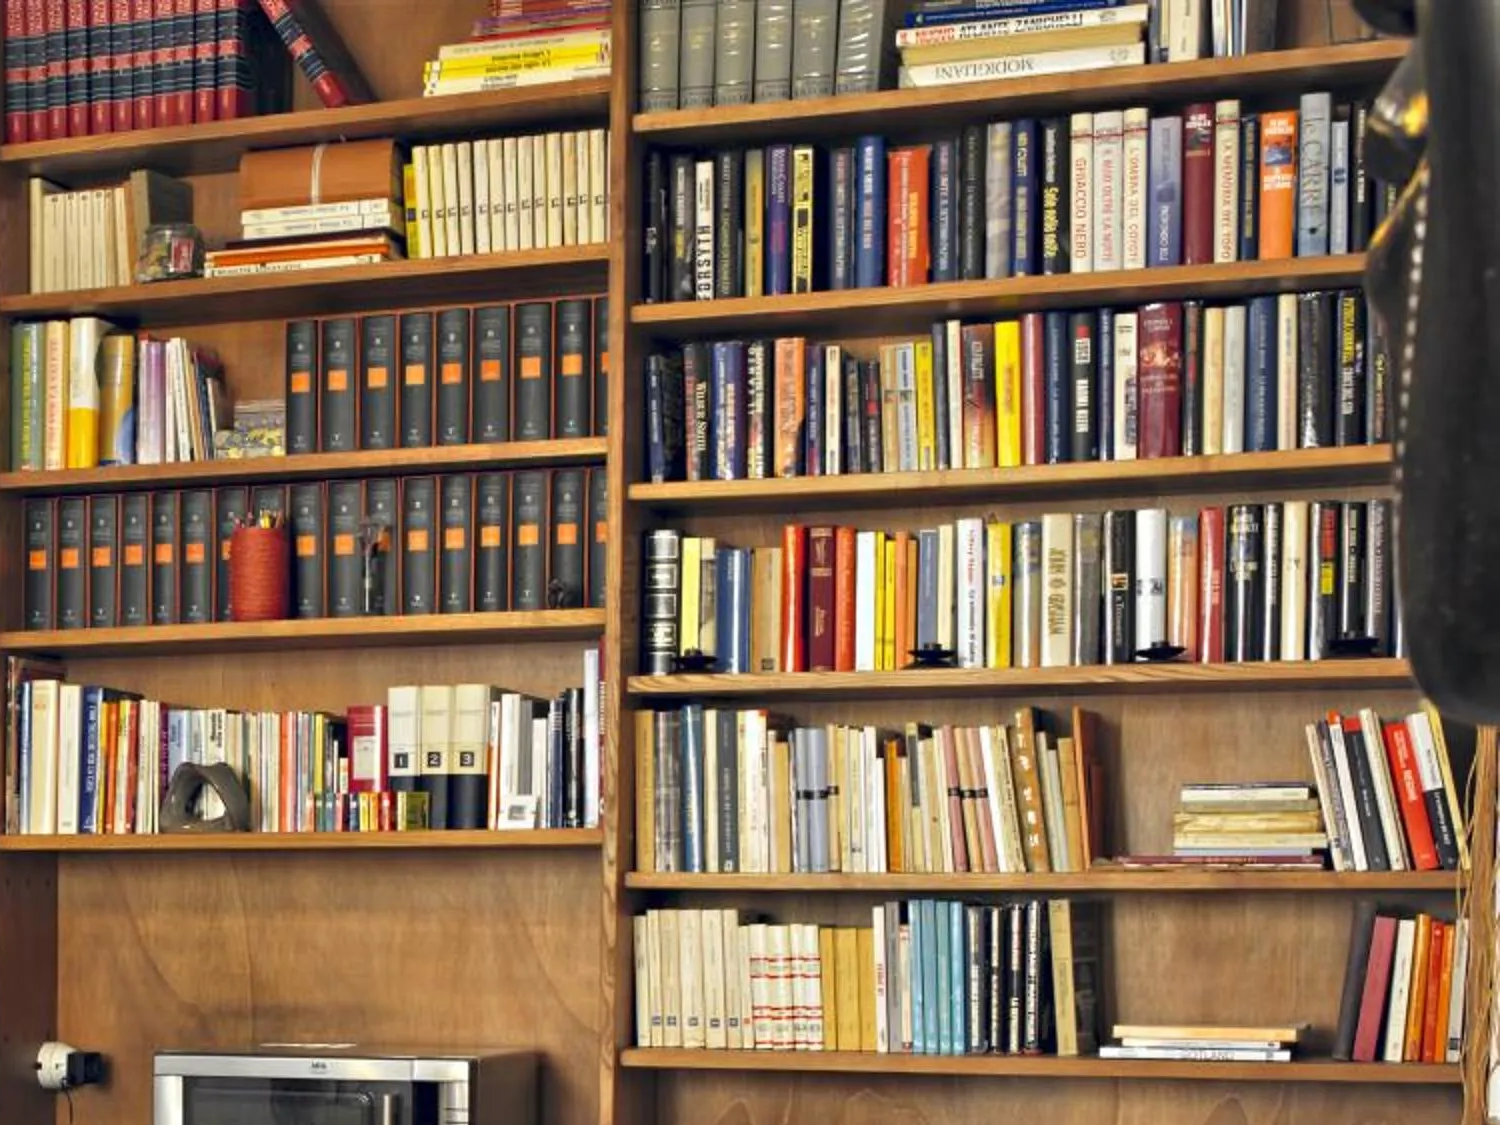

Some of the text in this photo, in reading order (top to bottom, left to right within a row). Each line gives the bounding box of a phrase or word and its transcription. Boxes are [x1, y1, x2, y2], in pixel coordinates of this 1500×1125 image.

[935, 58, 1035, 80] MODIGLIANI
[1075, 157, 1088, 220] GHIACCIO
[1221, 155, 1234, 207] MEMORIA
[1220, 232, 1232, 260] TOPO
